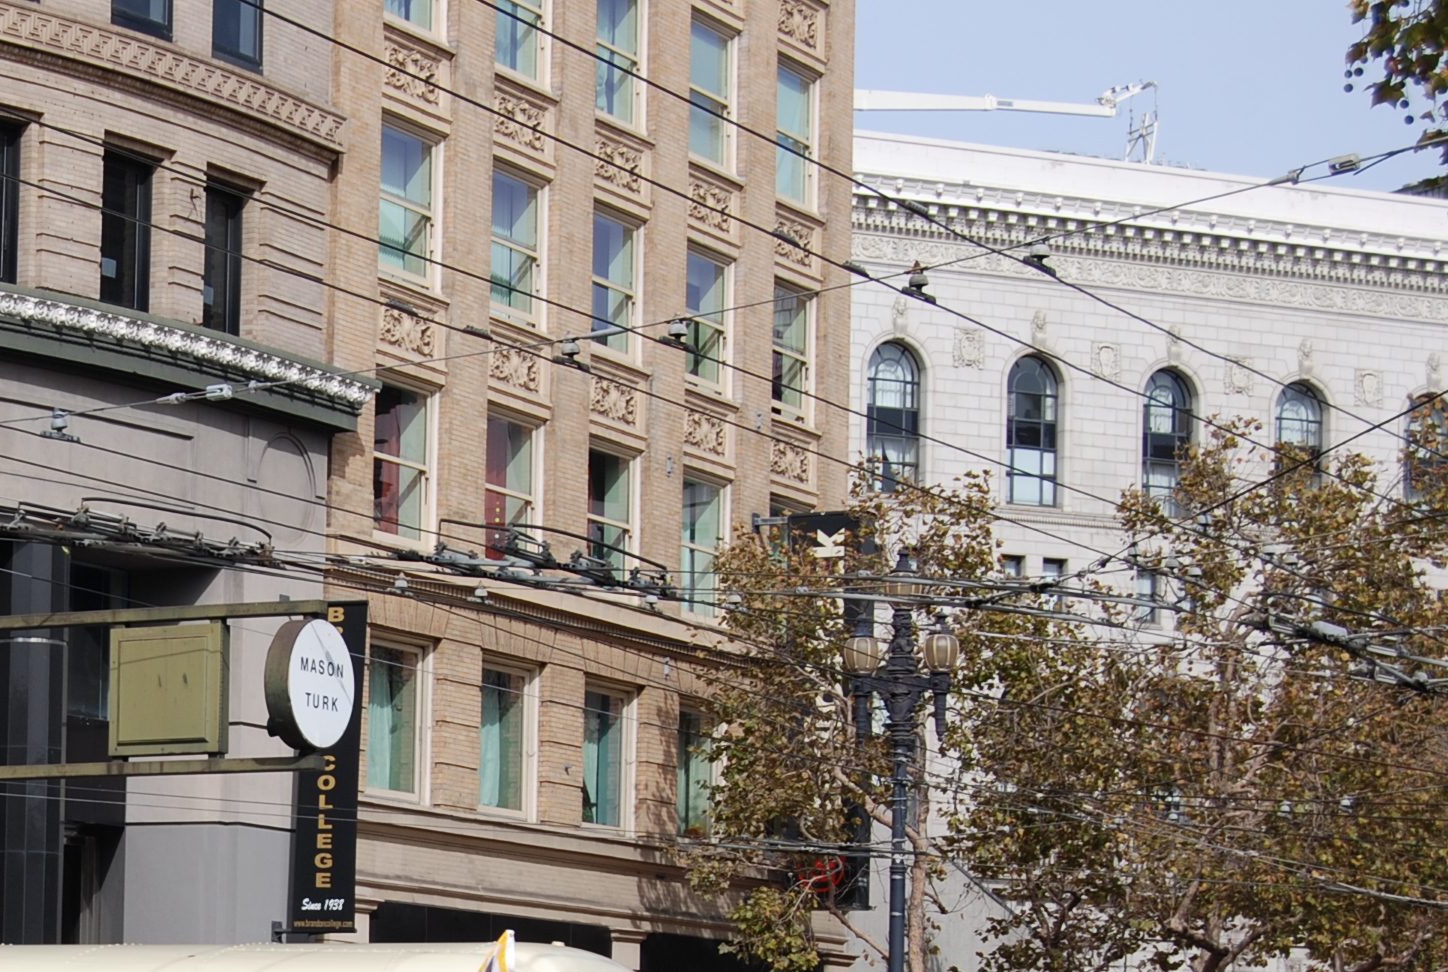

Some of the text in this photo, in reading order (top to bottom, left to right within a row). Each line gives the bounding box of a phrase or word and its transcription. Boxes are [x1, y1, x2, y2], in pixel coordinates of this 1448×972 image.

[300, 656, 344, 679] MASON
[305, 692, 339, 712] TURK
[301, 898, 344, 911] Since 1938
